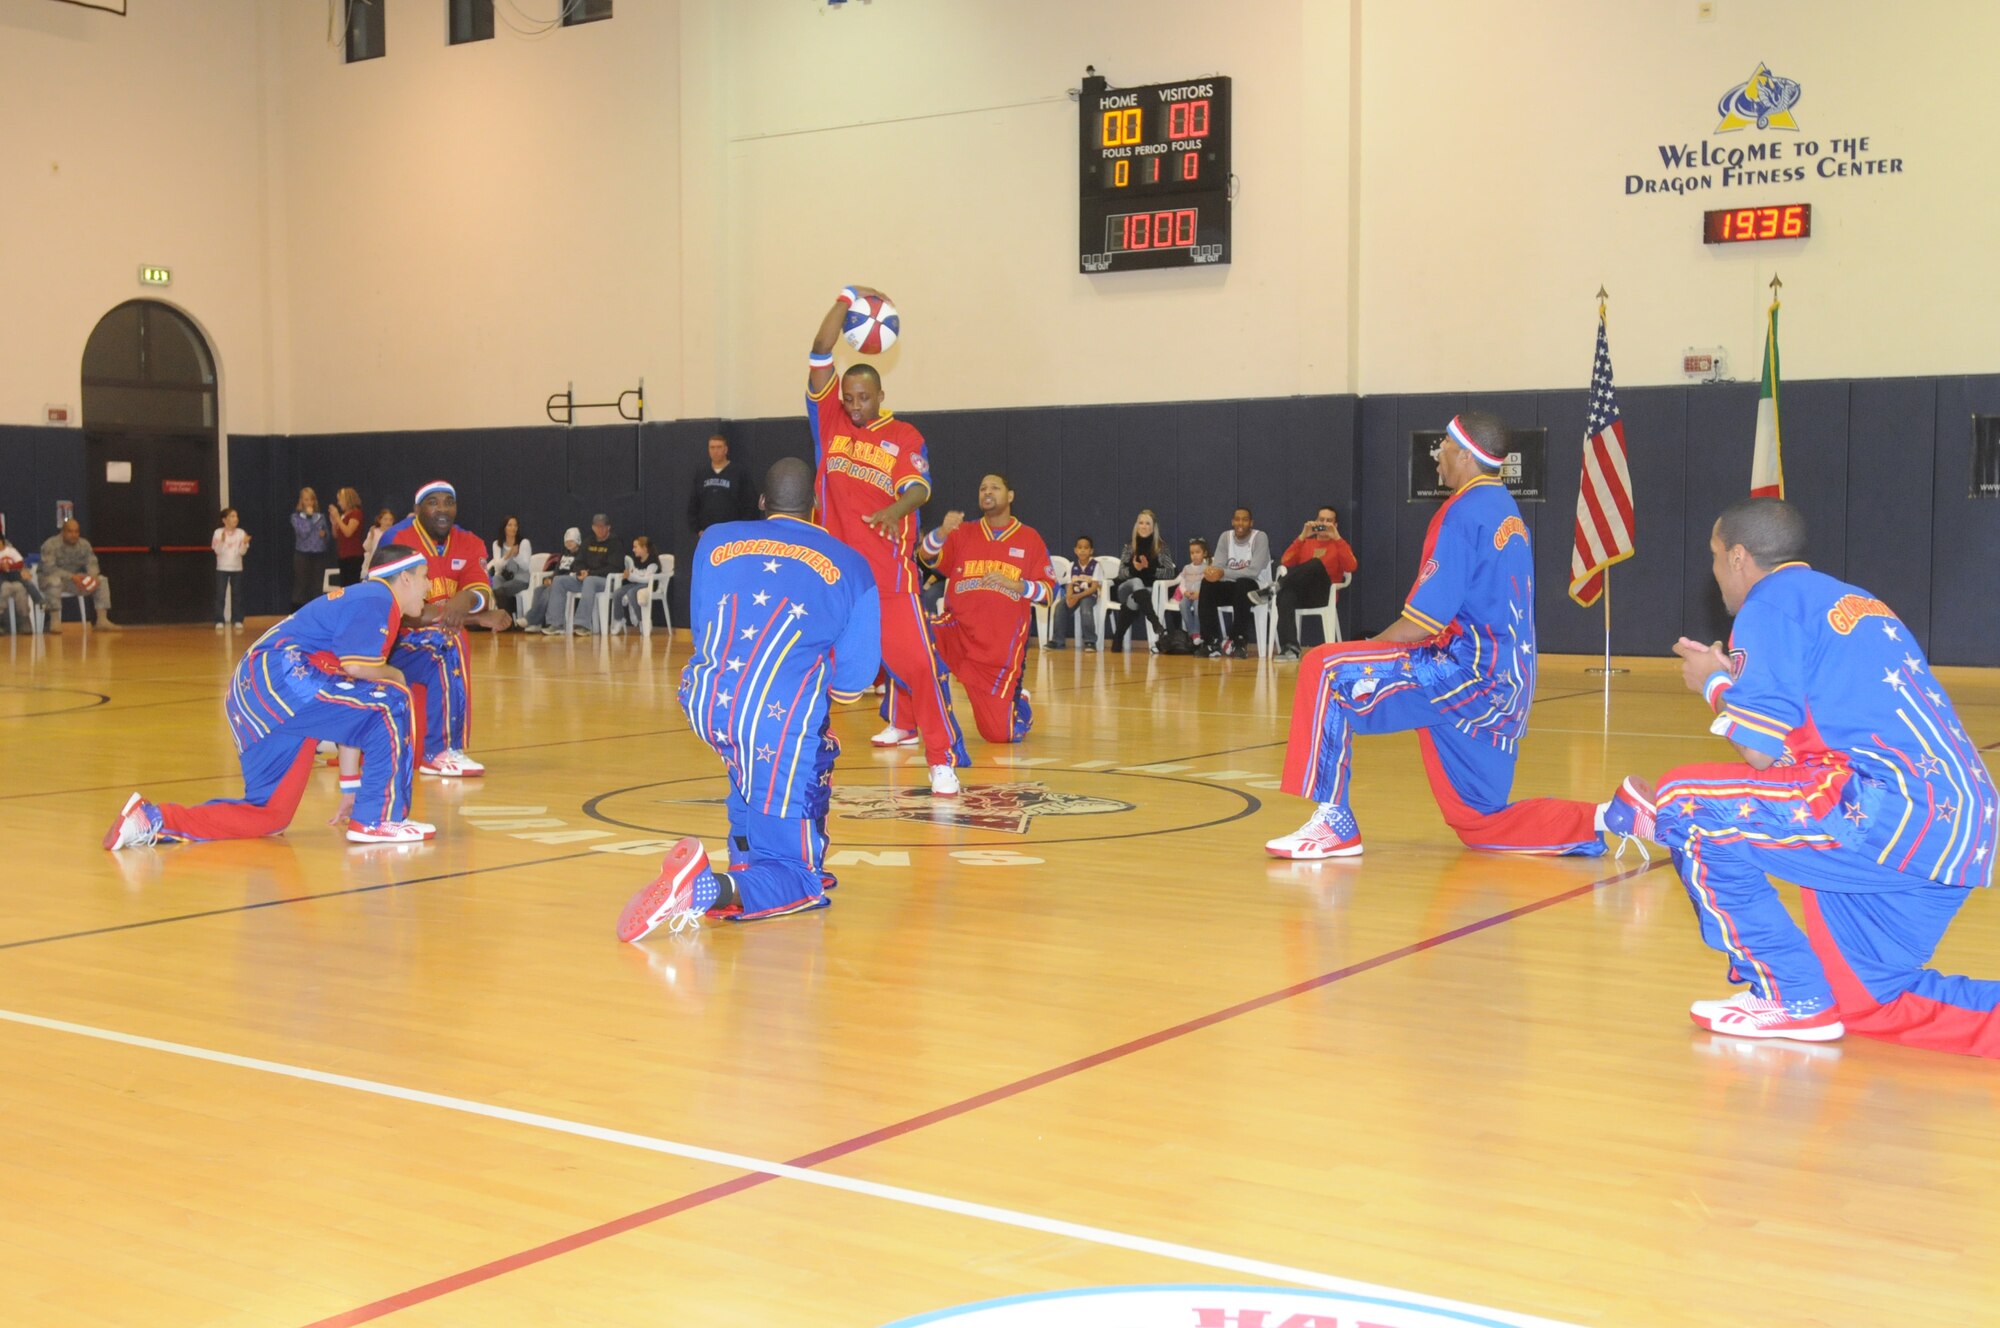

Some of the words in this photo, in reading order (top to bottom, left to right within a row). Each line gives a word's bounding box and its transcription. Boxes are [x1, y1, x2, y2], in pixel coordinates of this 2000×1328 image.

[1100, 94, 1137, 110] HOME
[1158, 84, 1214, 102] VISITORS
[1102, 108, 1142, 147] 00
[1169, 100, 1210, 139] 00
[1102, 146, 1132, 158] FOULS
[1135, 143, 1168, 156] PERIOD
[1171, 139, 1202, 151] FOULS
[1658, 140, 1782, 169] WELCOME
[1794, 141, 1819, 156] TO
[1830, 137, 1870, 159] THE
[1114, 160, 1129, 187] 0
[1183, 152, 1198, 180] 0
[1625, 174, 1712, 195] DRAGON
[1722, 165, 1806, 187] FITNESS
[1816, 157, 1903, 178] CENTER
[1207, 253, 1219, 262] OUT
[828, 435, 897, 477] HARLEM
[710, 538, 841, 584] GLOBETROTTERS
